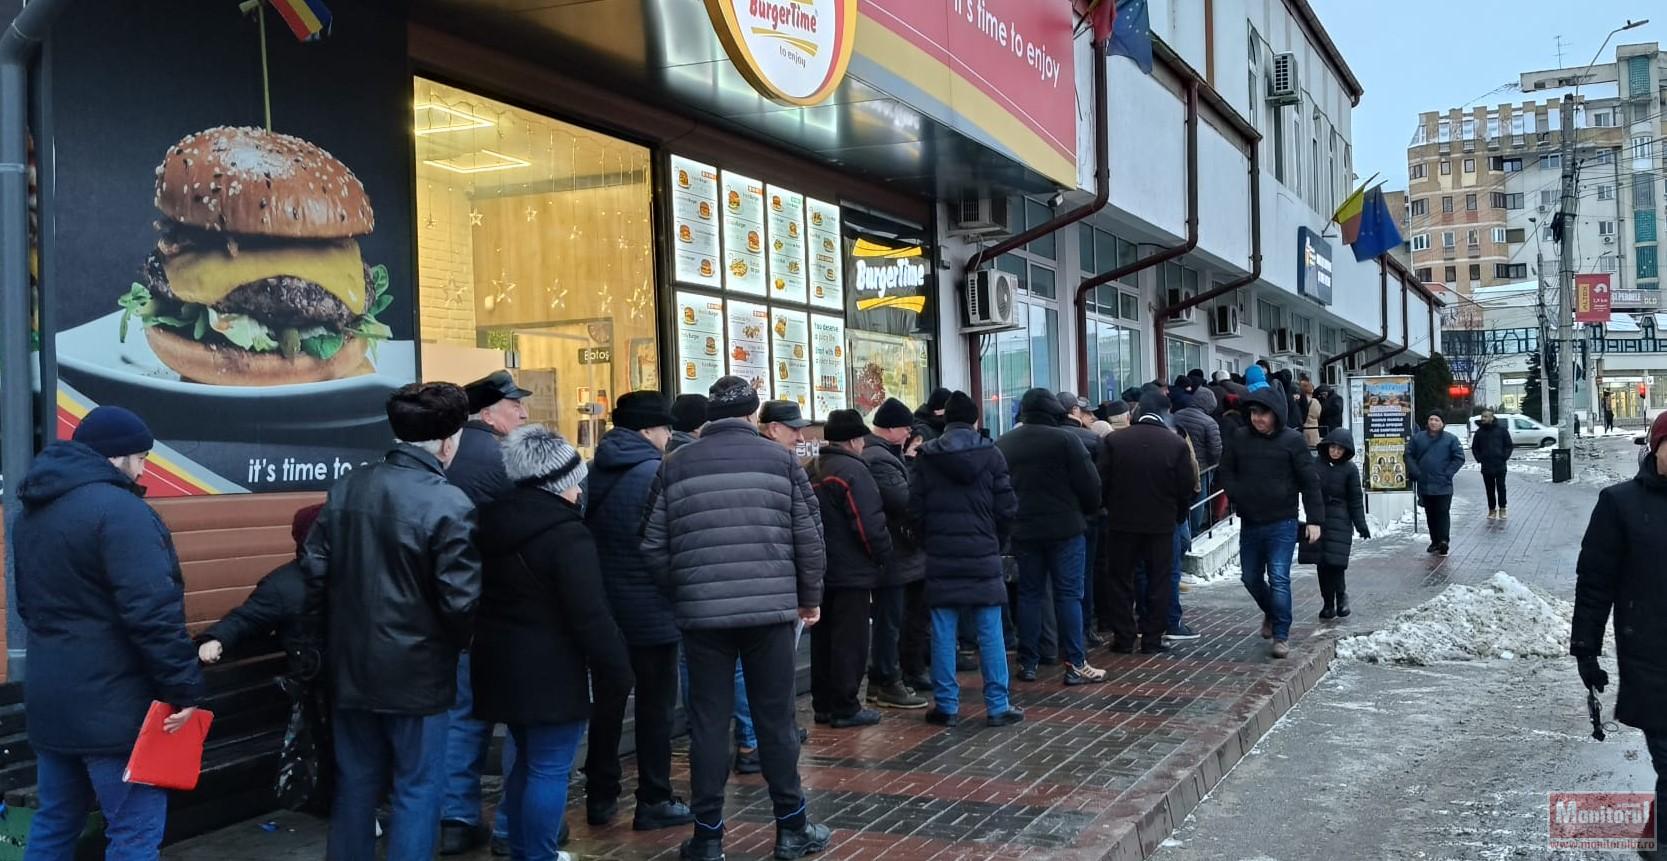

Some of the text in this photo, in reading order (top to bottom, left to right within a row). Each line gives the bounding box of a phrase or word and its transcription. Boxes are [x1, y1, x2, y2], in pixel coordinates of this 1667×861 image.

[750, 0, 817, 33] BurgerTime
[779, 45, 806, 68] to enjoy
[954, 0, 1060, 88] its time to enjoy
[856, 258, 925, 298] BurgerTime
[248, 458, 276, 483] it's
[283, 458, 328, 481] time
